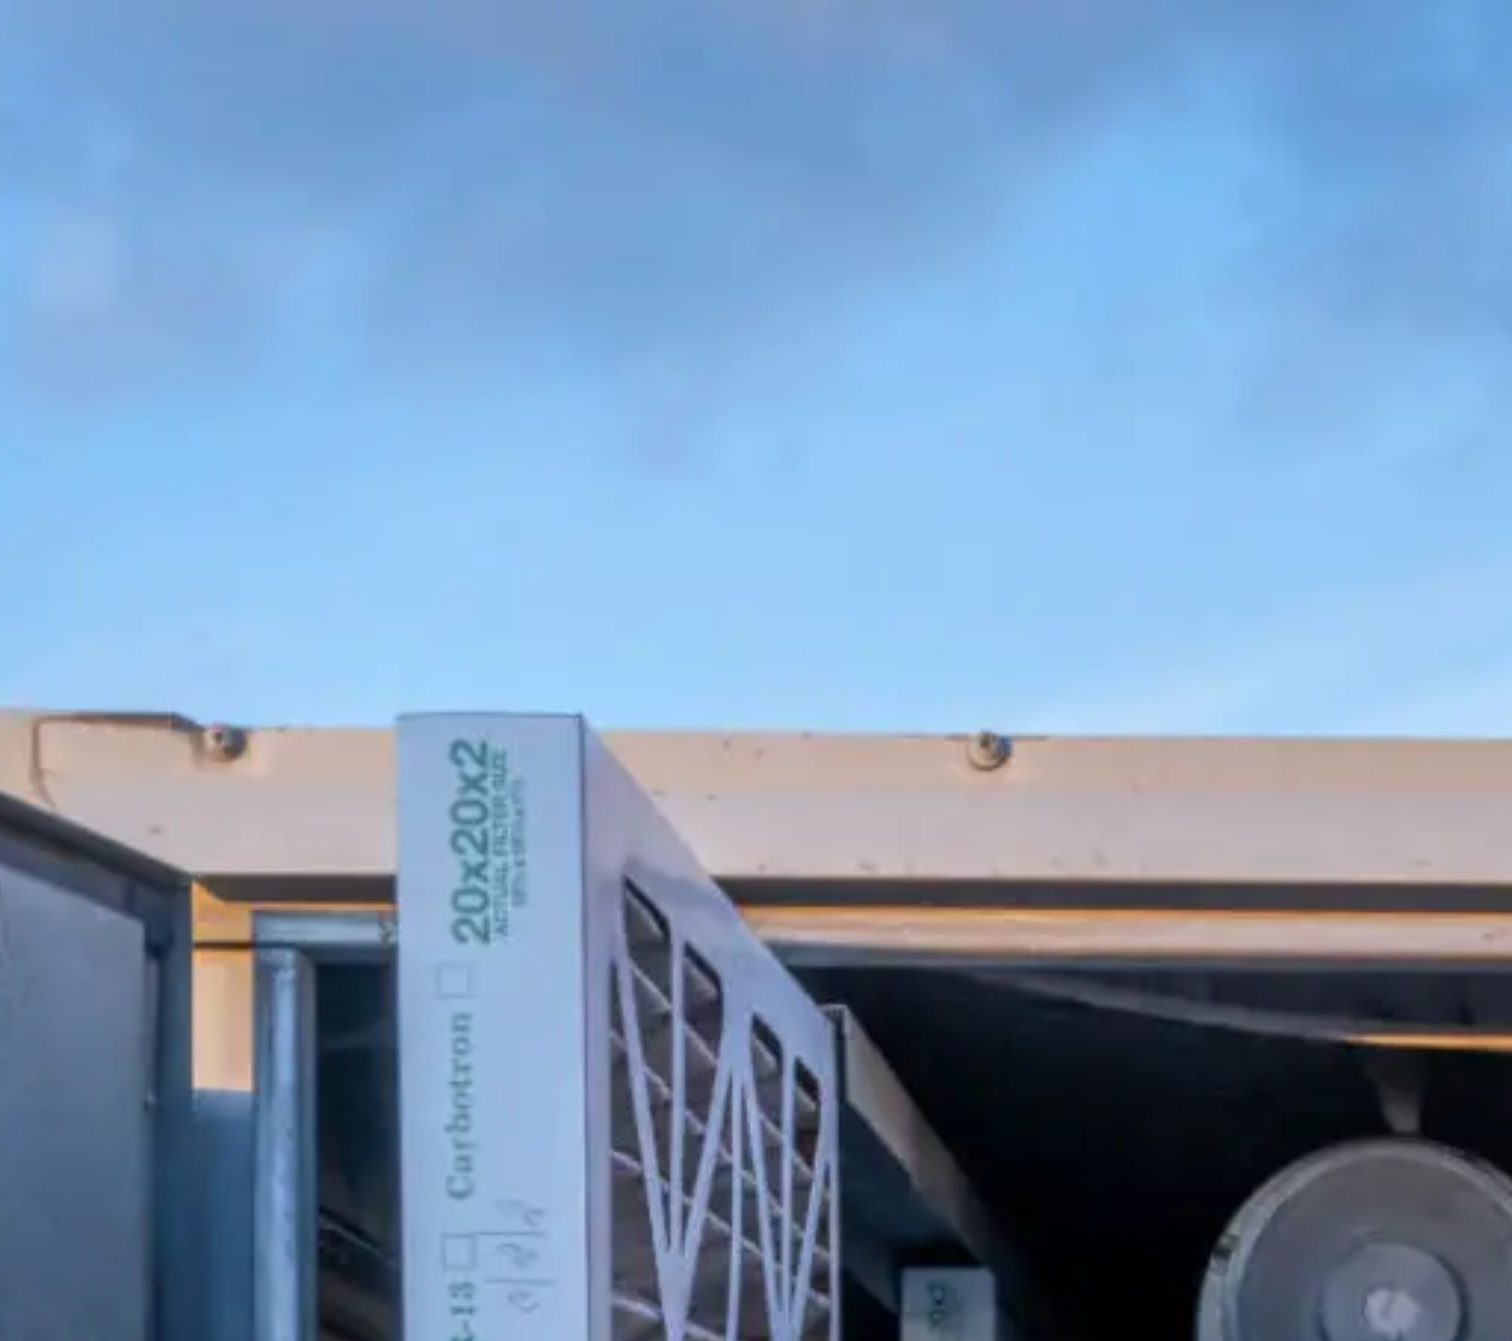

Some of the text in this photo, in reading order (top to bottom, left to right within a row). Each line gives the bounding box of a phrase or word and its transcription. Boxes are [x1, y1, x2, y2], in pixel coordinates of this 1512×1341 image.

[449, 739, 490, 946] 20x20x2
[492, 798, 508, 856] FILTER
[492, 861, 509, 938] ACTUAL
[444, 1012, 474, 1200] Carbotron
